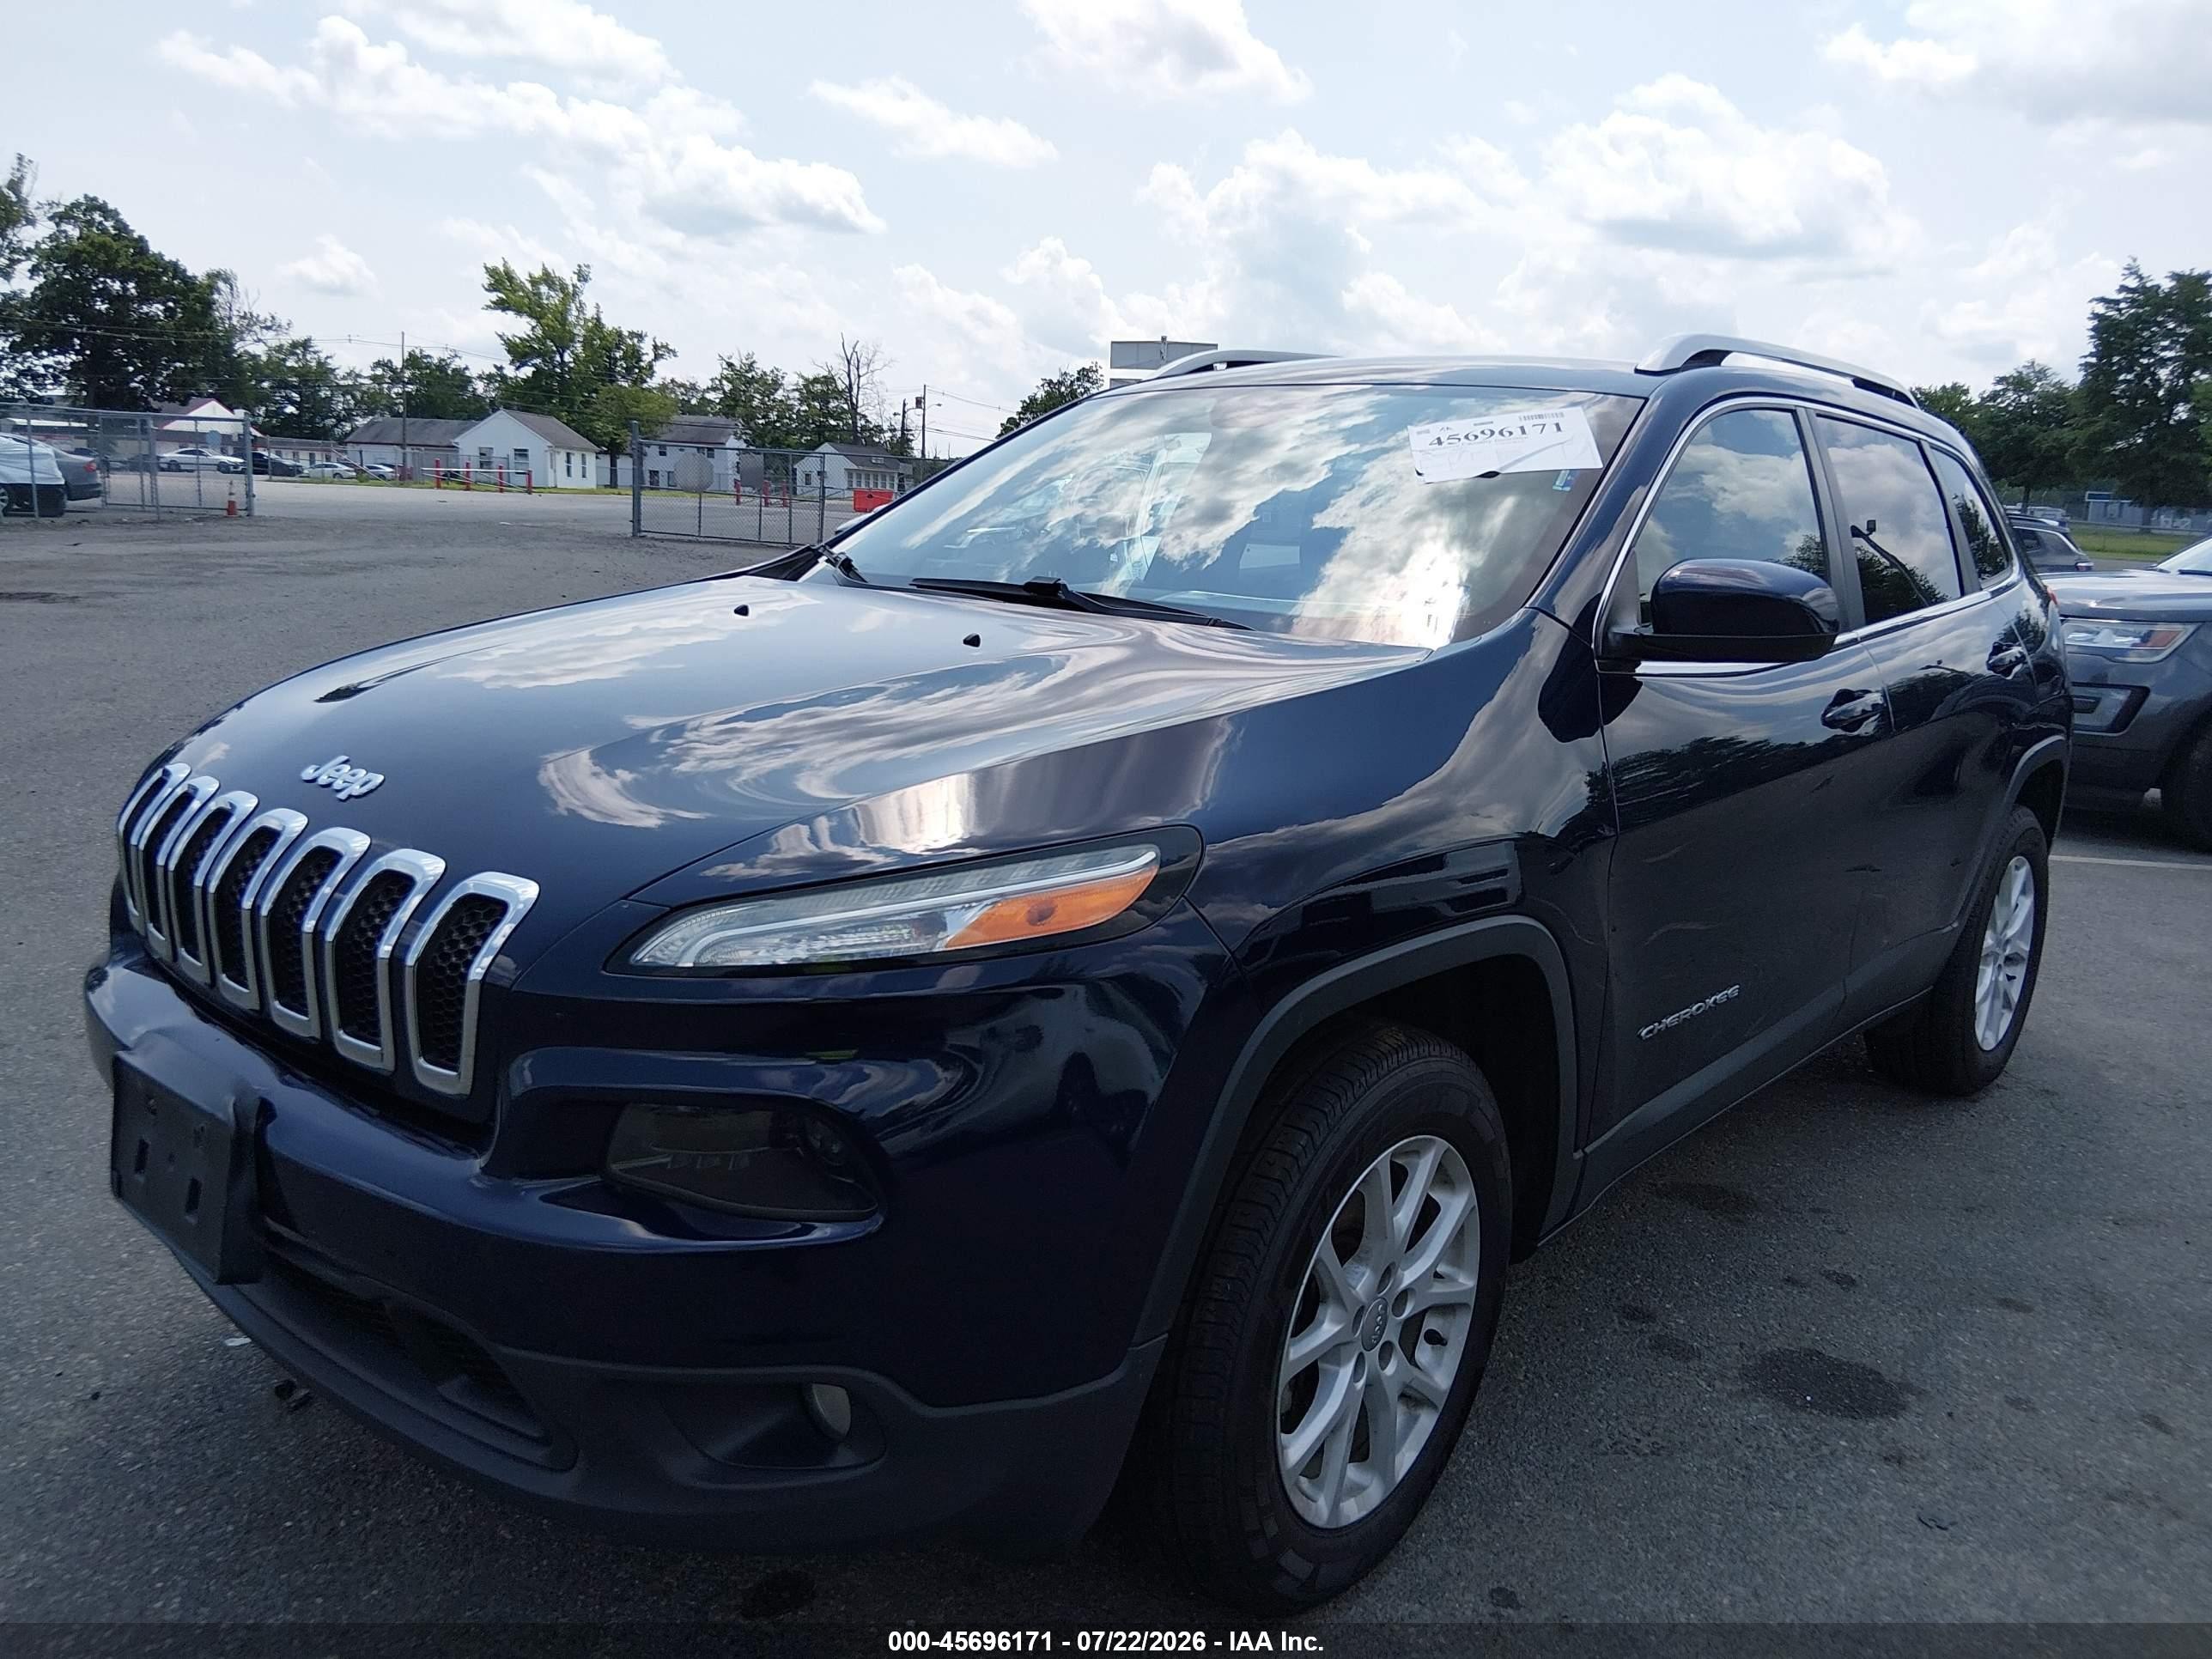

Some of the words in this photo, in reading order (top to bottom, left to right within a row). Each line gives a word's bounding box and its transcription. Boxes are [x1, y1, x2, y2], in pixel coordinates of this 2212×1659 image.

[1428, 422, 1563, 447] 45696171
[301, 755, 385, 800] Jeep
[1638, 984, 1741, 1040] CHEROKEE
